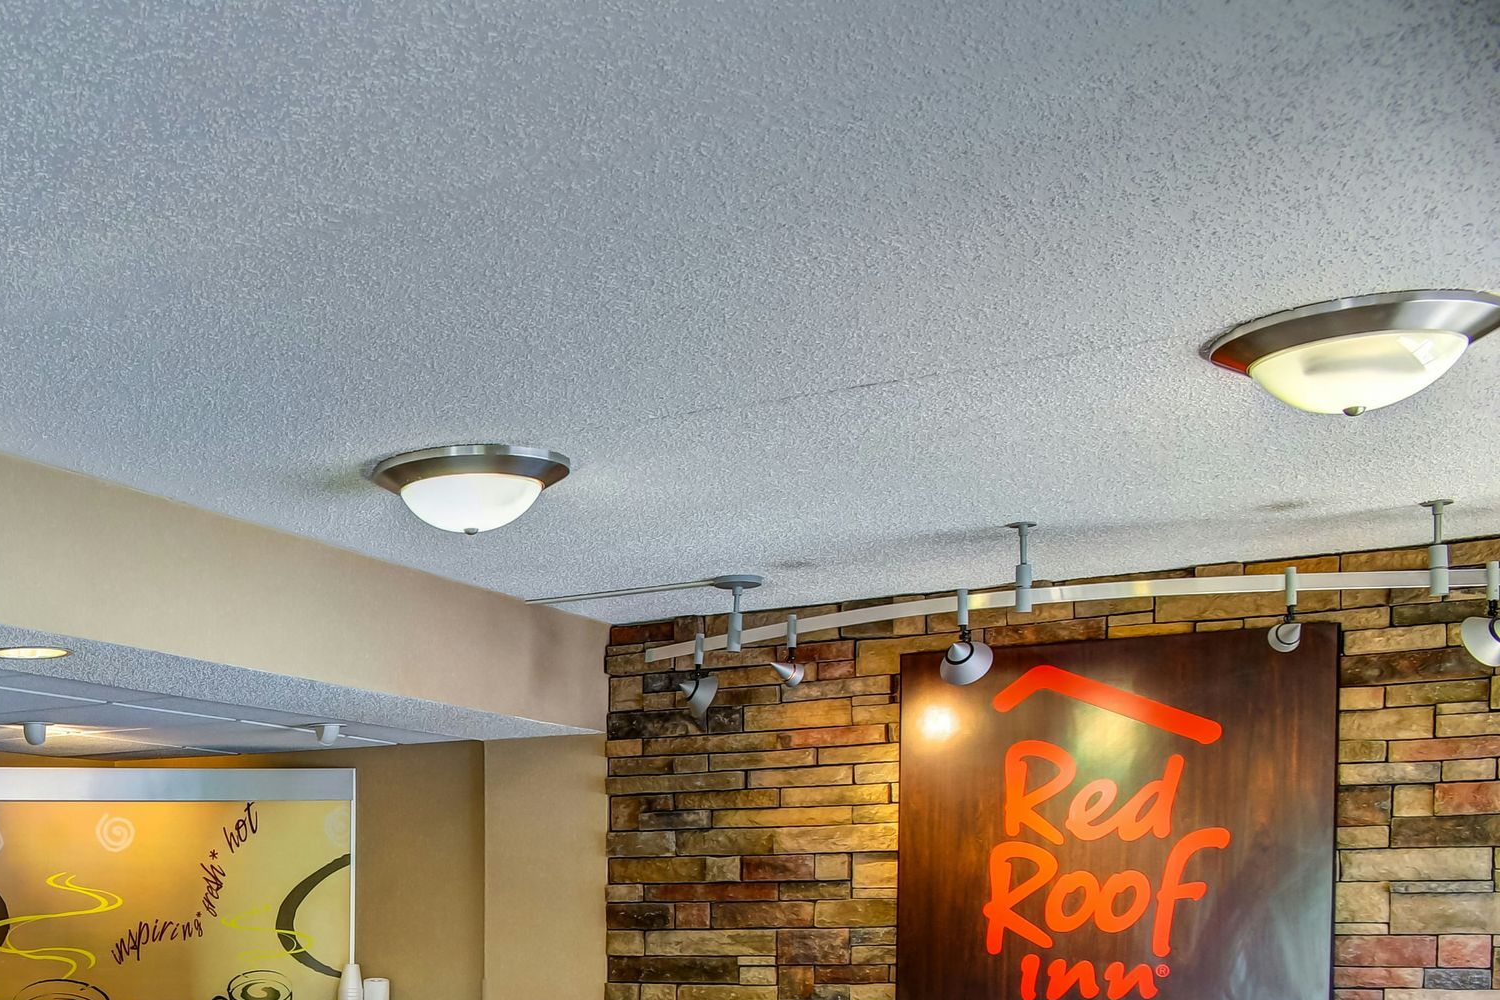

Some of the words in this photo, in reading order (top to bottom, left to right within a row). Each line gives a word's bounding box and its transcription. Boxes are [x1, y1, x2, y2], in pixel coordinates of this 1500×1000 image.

[223, 801, 258, 853] hot
[1004, 739, 1185, 845] Red
[982, 827, 1231, 957] Roof
